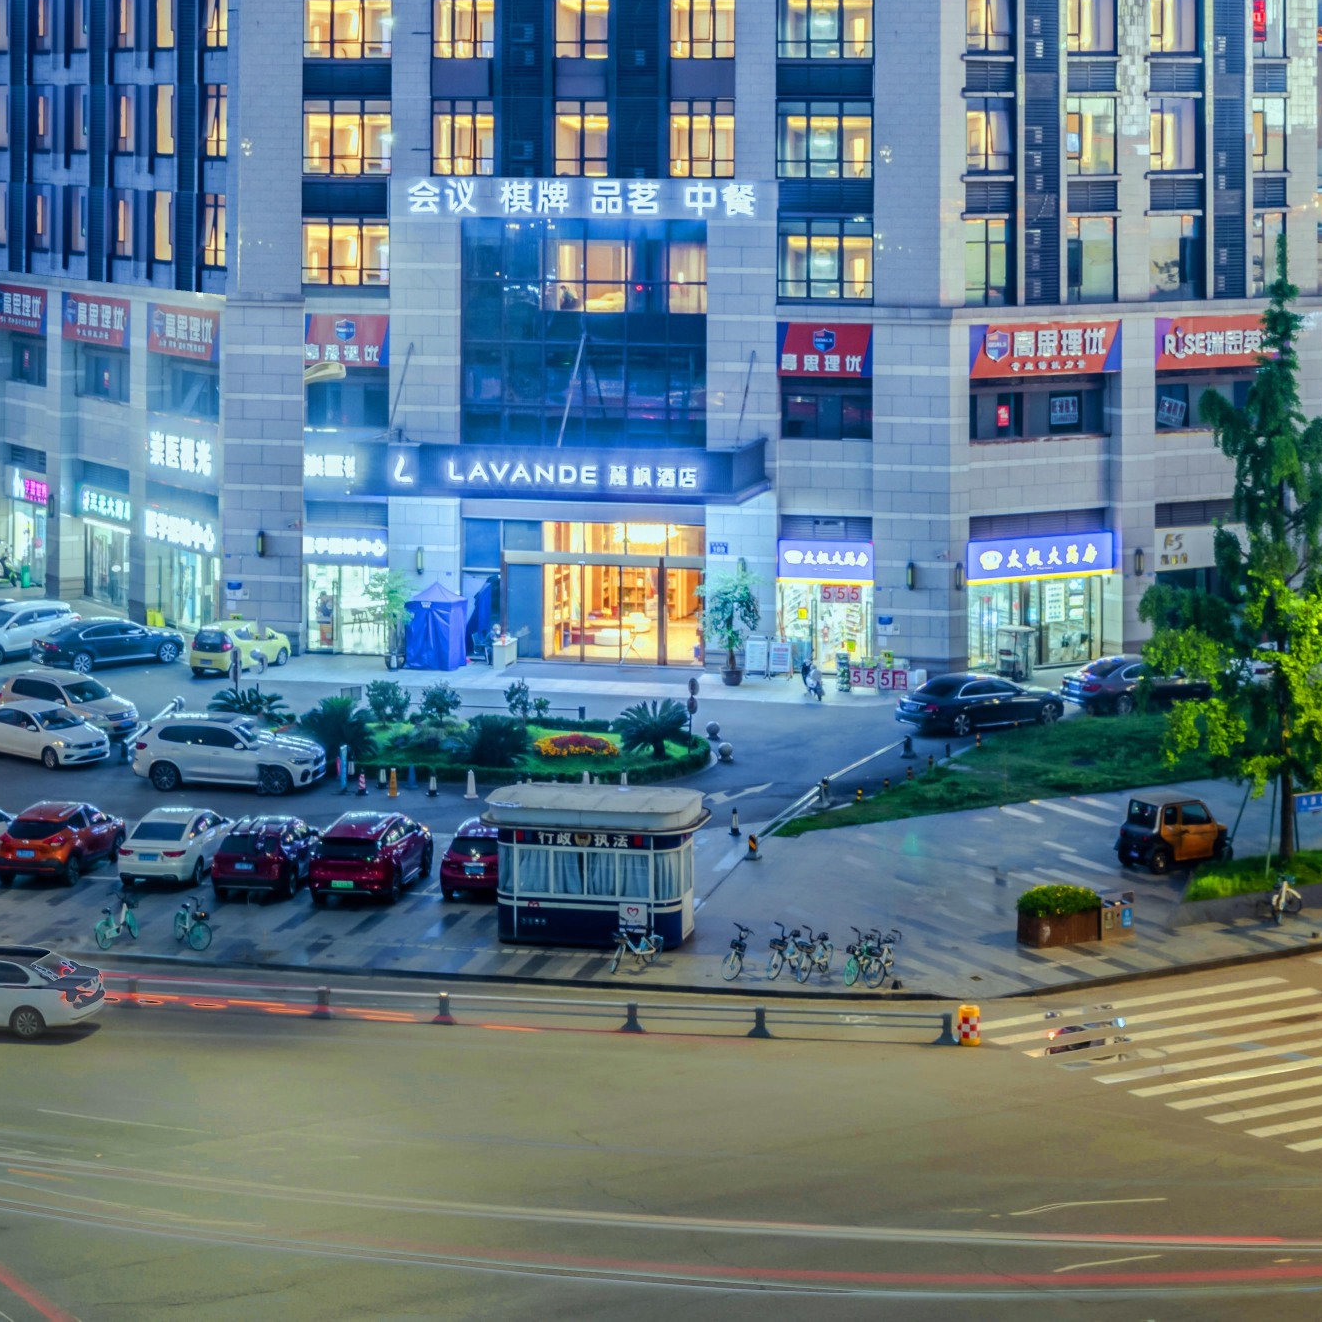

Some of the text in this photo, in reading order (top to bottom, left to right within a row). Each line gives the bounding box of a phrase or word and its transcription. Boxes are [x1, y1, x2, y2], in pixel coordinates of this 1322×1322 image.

[408, 180, 756, 217] 会议 棋牌 品茗 中餐
[2, 292, 41, 319] 高思理优
[77, 302, 125, 331] 高思理优
[165, 312, 213, 344] 高思理优
[1013, 328, 1107, 358] 高思理优
[781, 353, 862, 372] 高思理优
[448, 460, 597, 485] LAVANDE
[1006, 543, 1098, 569] 太极大药房
[537, 831, 629, 848] 行政 执法
